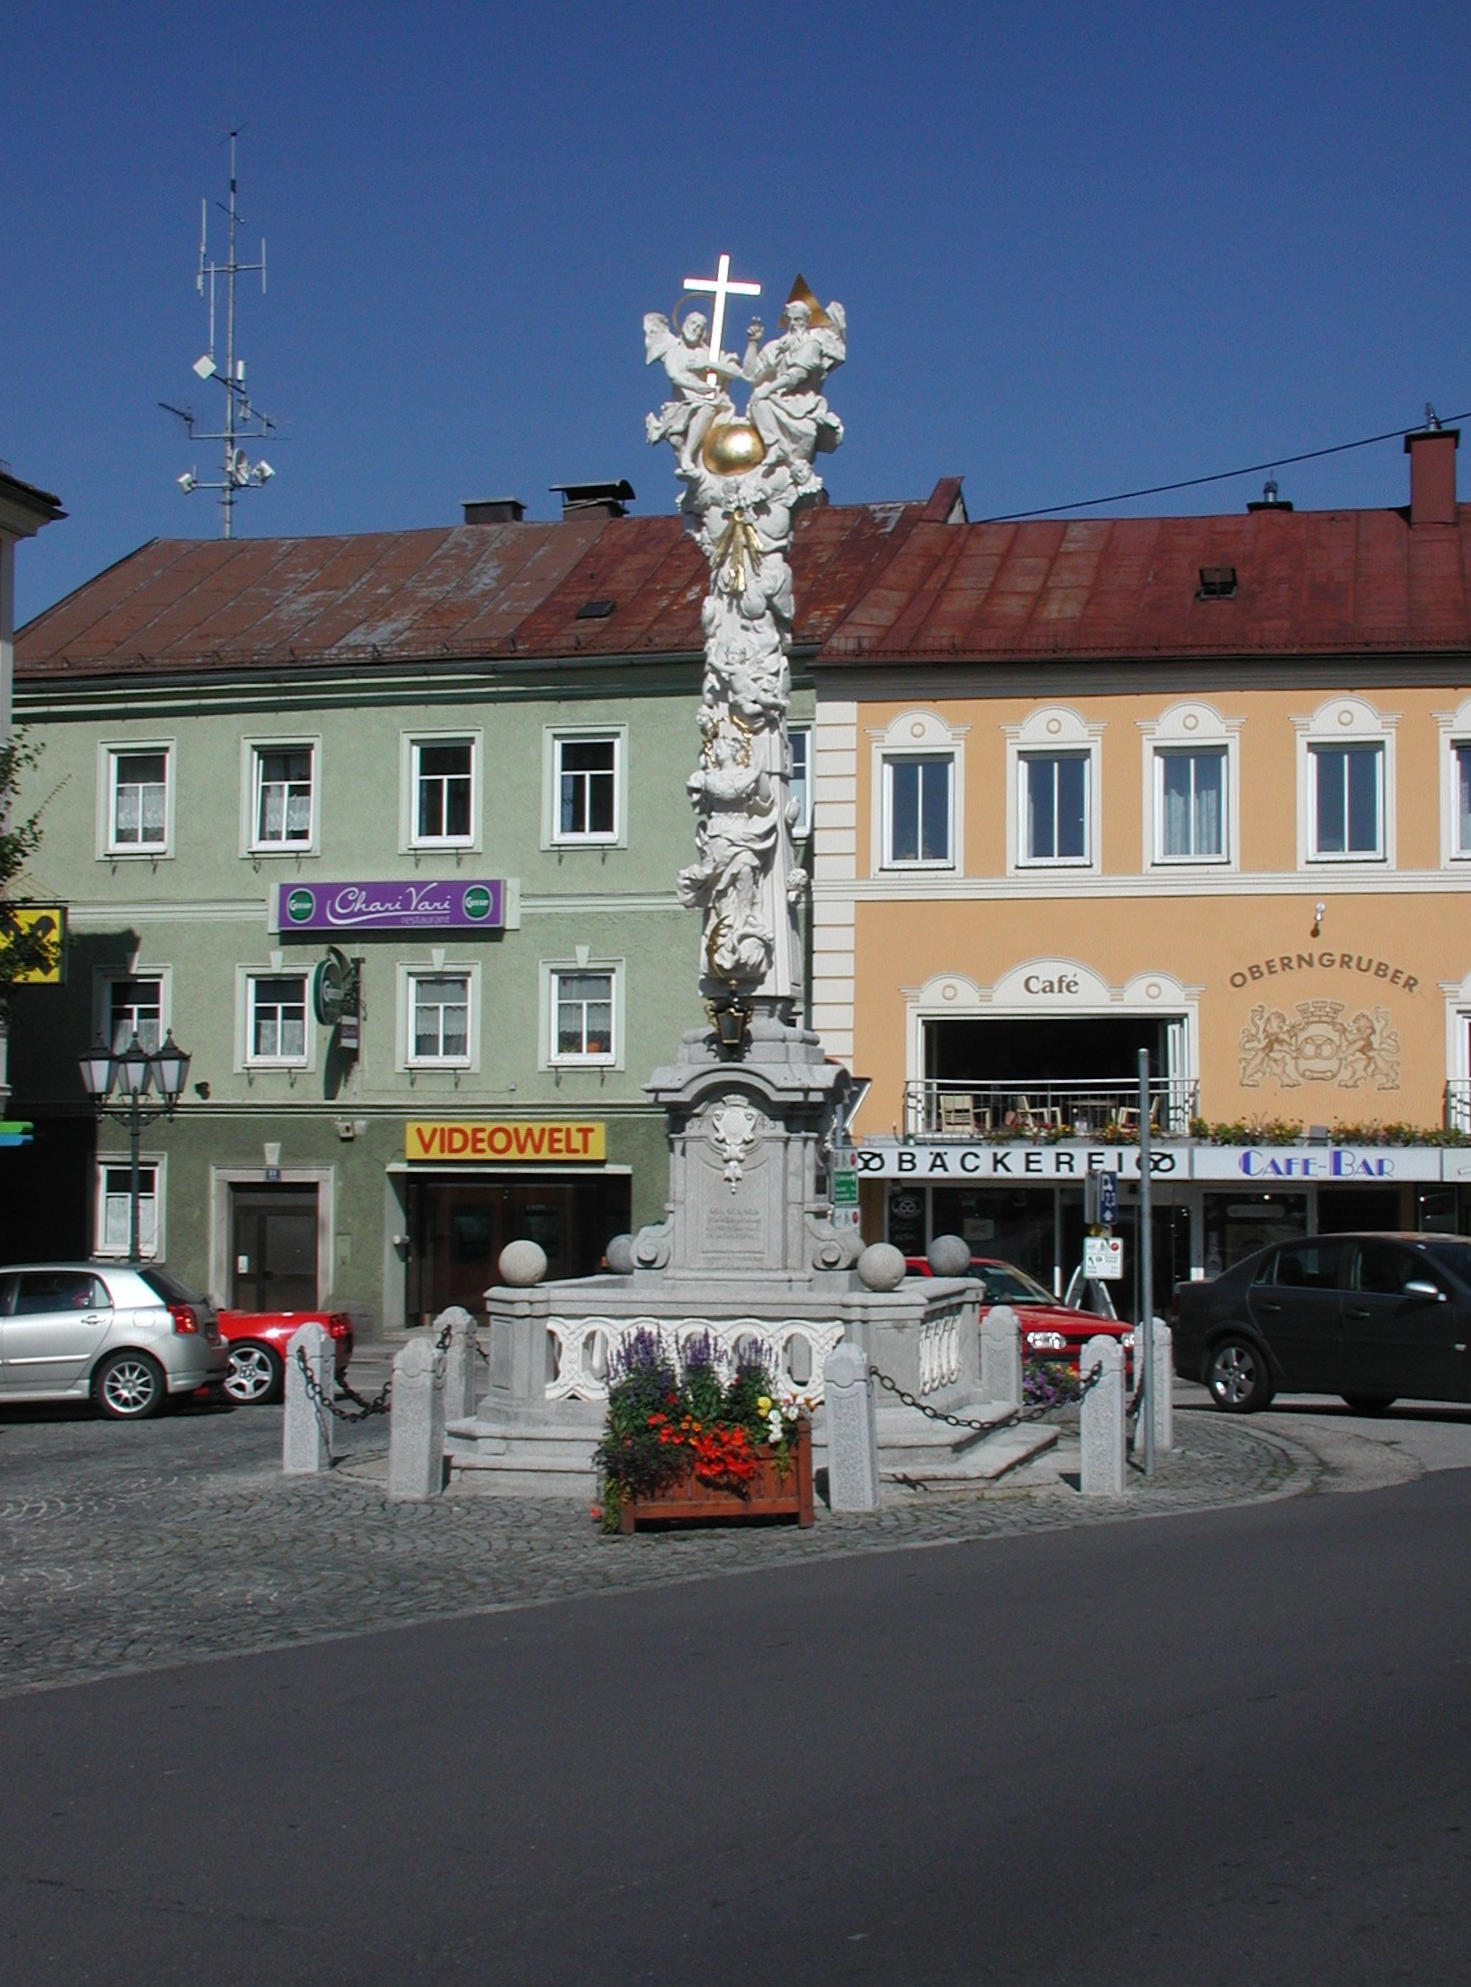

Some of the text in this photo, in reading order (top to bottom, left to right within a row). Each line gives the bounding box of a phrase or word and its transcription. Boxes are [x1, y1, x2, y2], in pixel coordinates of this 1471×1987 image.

[334, 882, 451, 914] Chari Vari
[401, 915, 450, 925] restaurant
[1023, 973, 1079, 995] Café
[1229, 952, 1419, 993] OBERNGRUBER
[416, 1127, 595, 1154] VIDEOWELT
[897, 1151, 1124, 1173] BÄCKEREI
